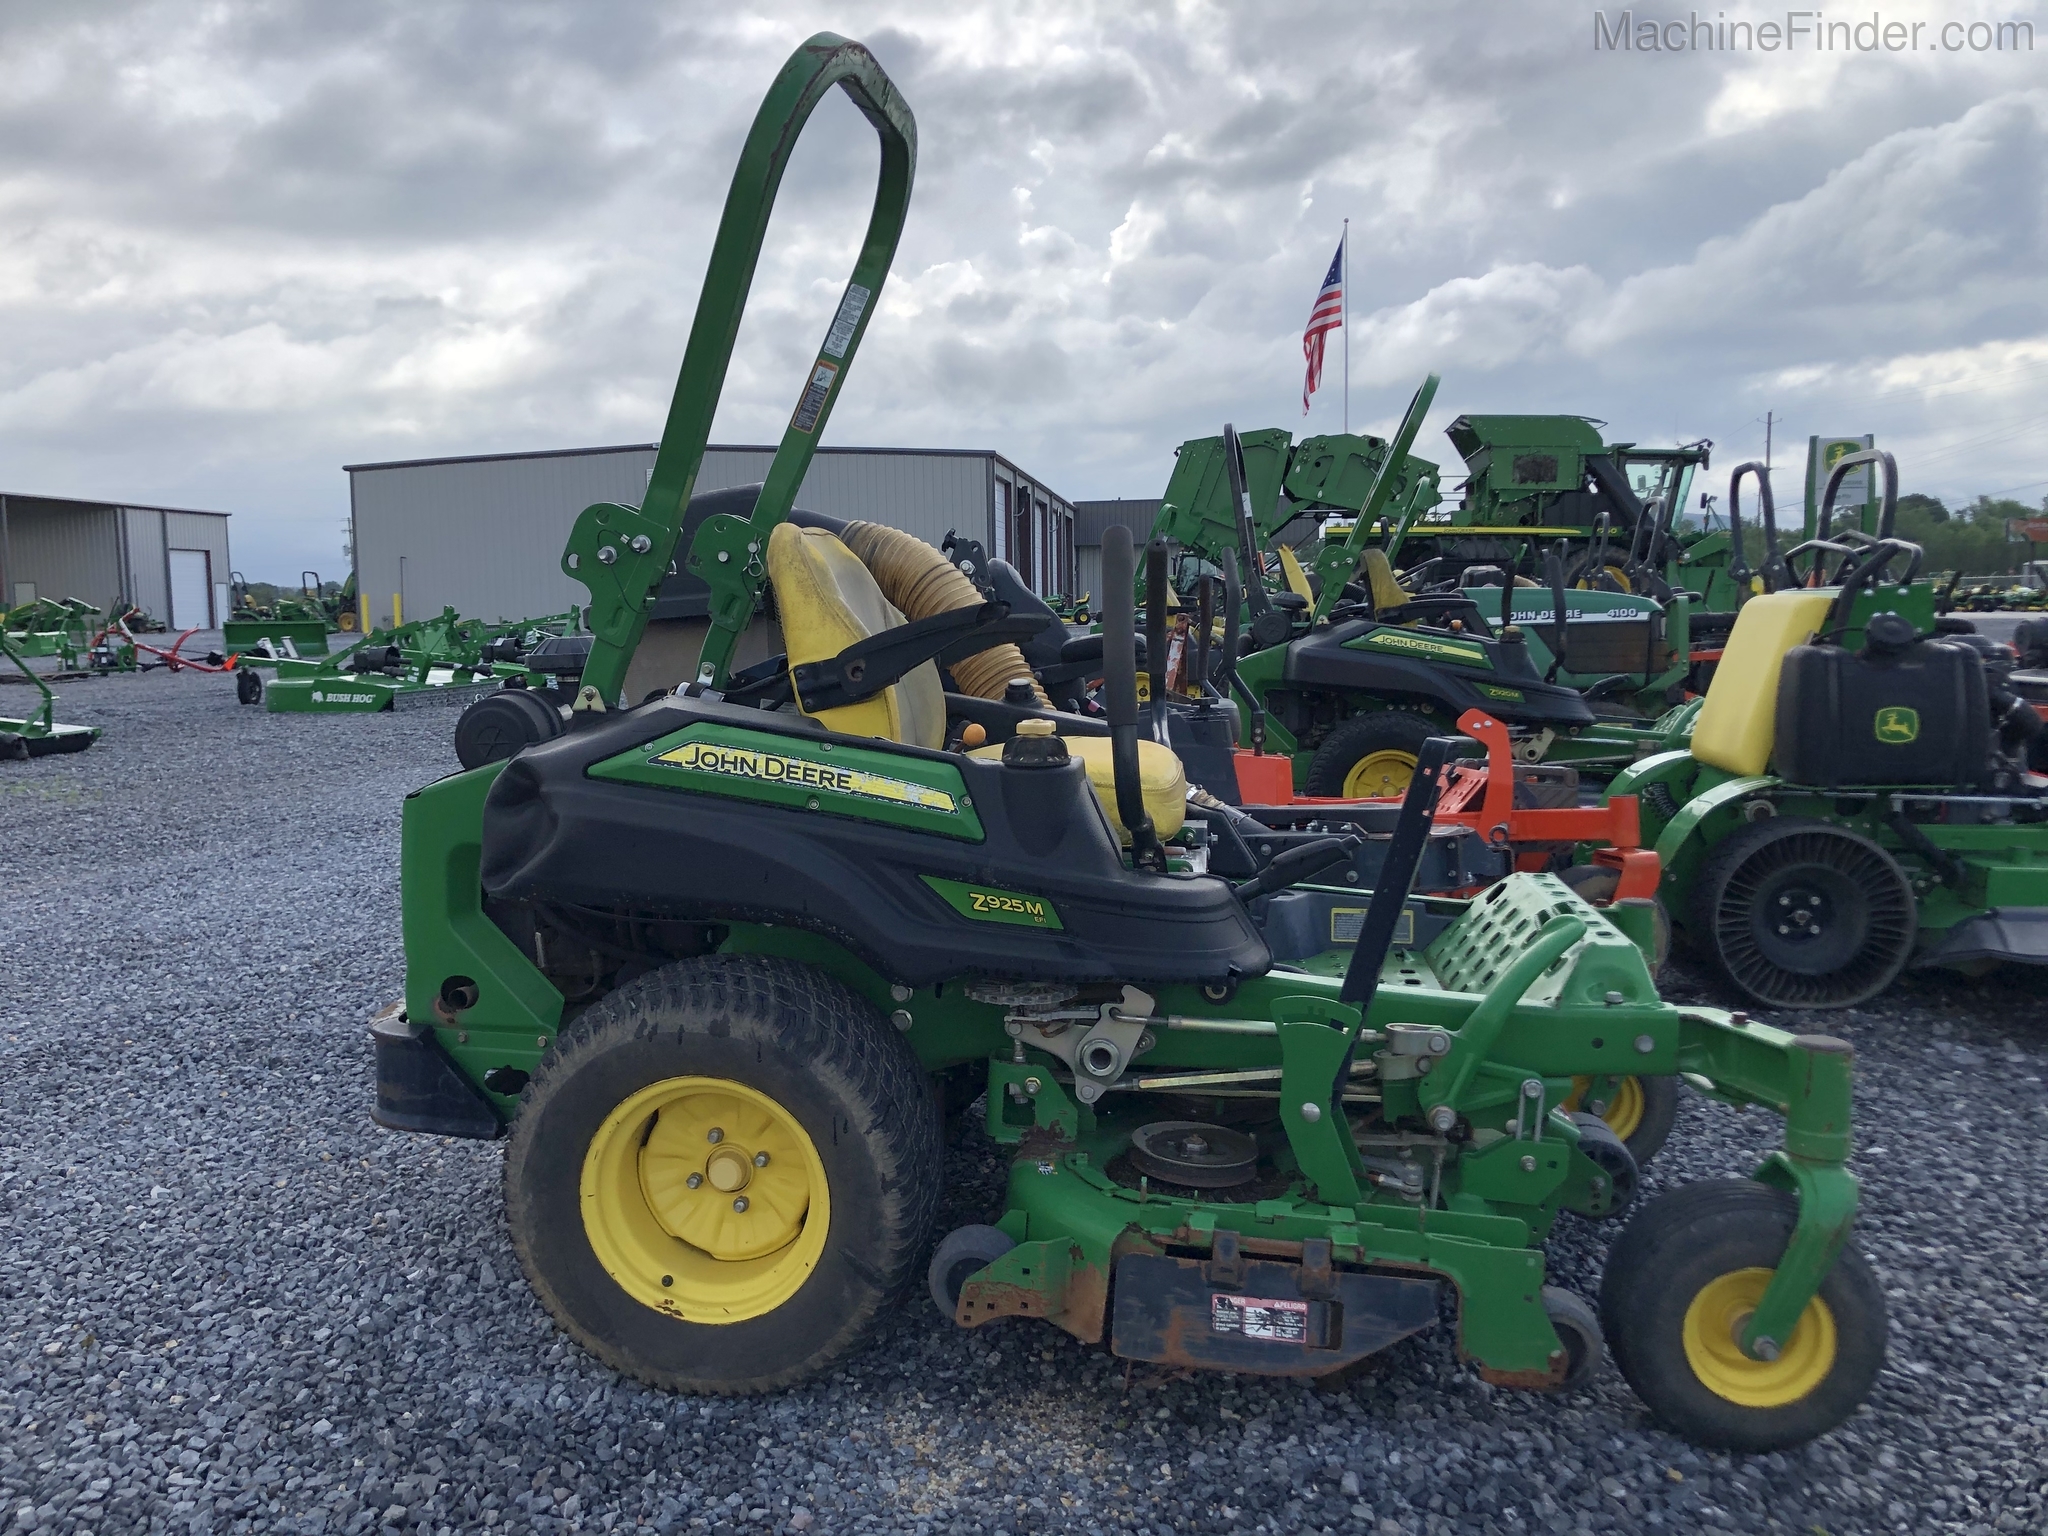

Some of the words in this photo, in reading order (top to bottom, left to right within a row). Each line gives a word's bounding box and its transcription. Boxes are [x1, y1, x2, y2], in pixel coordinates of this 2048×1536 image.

[1509, 611, 1536, 620] OHN
[1541, 609, 1581, 620] DERE
[1607, 608, 1637, 618] 4100
[1379, 635, 1407, 647] JOHN
[1409, 639, 1443, 652] DEERE
[326, 693, 352, 702] BUSH
[684, 746, 758, 775] JOHN
[764, 756, 852, 790] DEERE
[969, 892, 1045, 916] Z925M
[1280, 1301, 1307, 1310] PELIGRO
